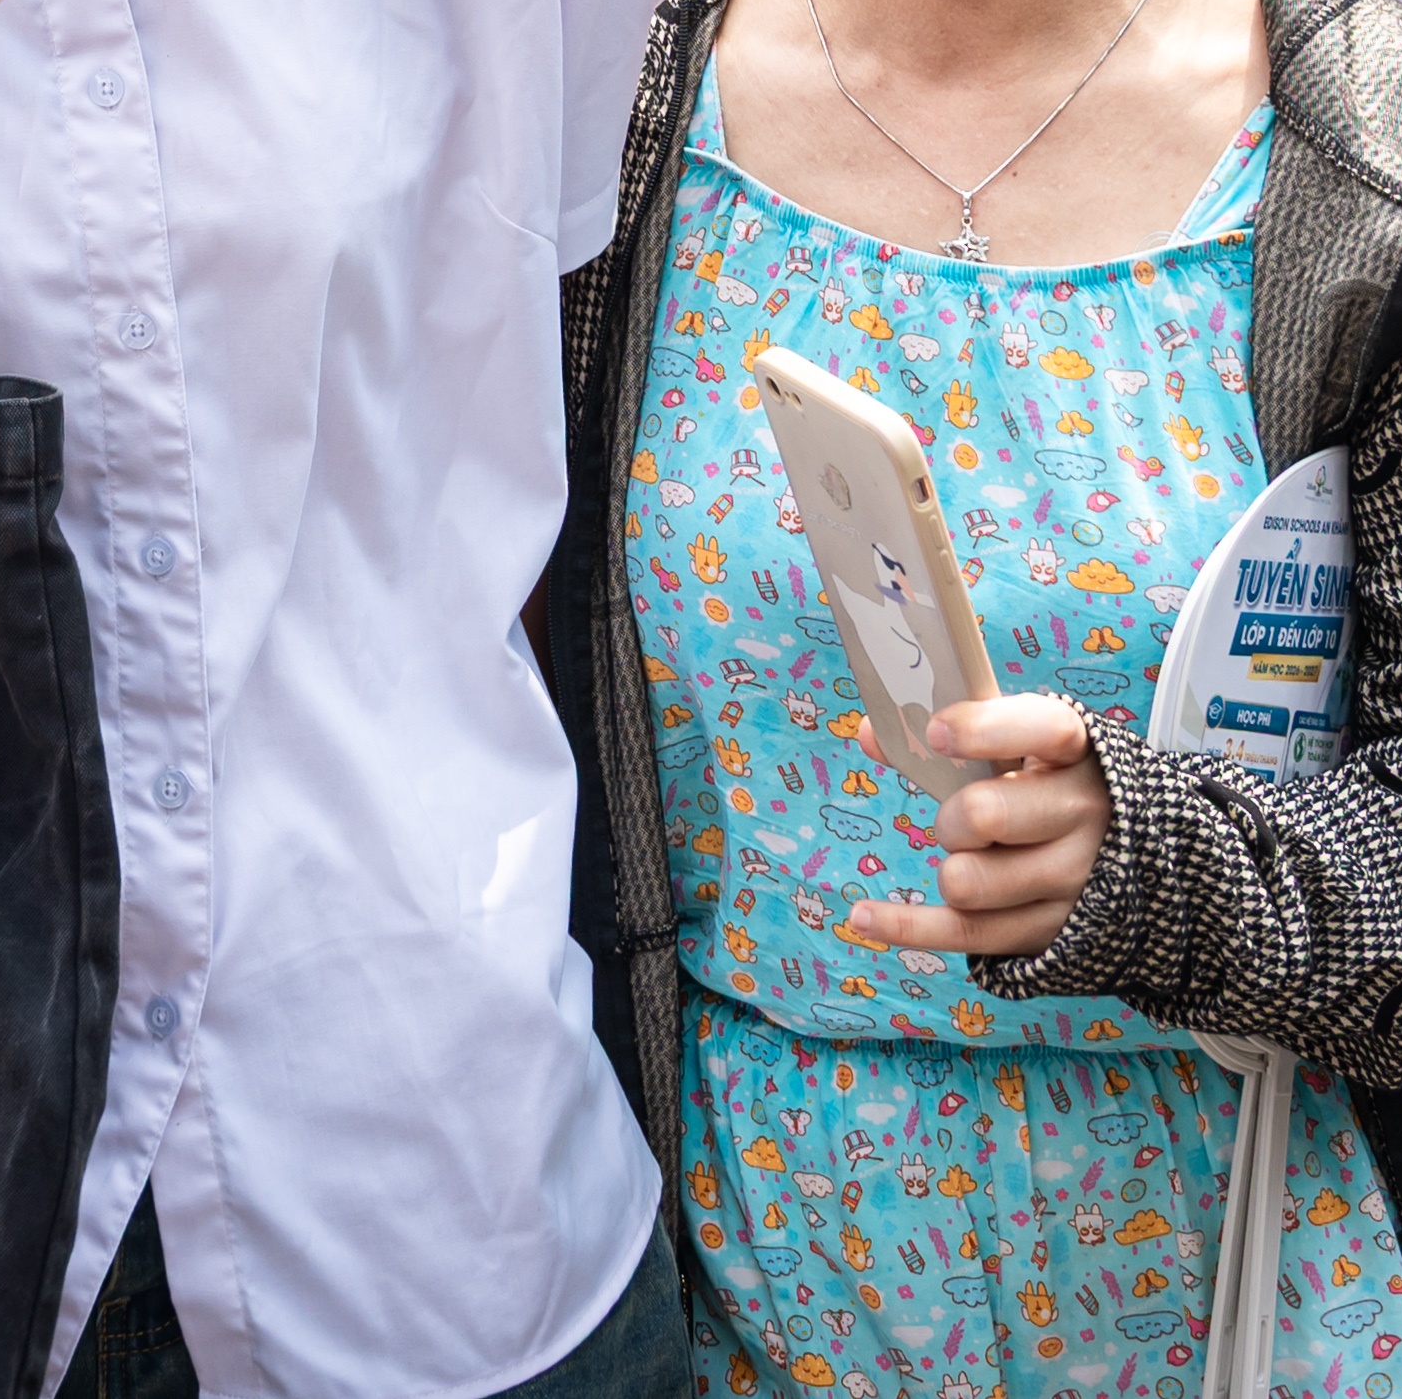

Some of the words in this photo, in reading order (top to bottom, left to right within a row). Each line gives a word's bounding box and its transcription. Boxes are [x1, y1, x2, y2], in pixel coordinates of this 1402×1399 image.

[1263, 516, 1290, 531] EDISON
[1290, 517, 1321, 533] SCHOOLS
[1321, 520, 1330, 534] AN
[1234, 537, 1310, 608] TUYỂN
[1310, 563, 1353, 609] SINH
[1240, 619, 1266, 646] LỚP
[1267, 625, 1275, 646] 1
[1277, 620, 1302, 648] ĐẾN
[1302, 623, 1323, 649] LỚP
[1325, 629, 1337, 649] 10
[1236, 709, 1255, 727] HỌC
[1257, 709, 1273, 727] PHÍ
